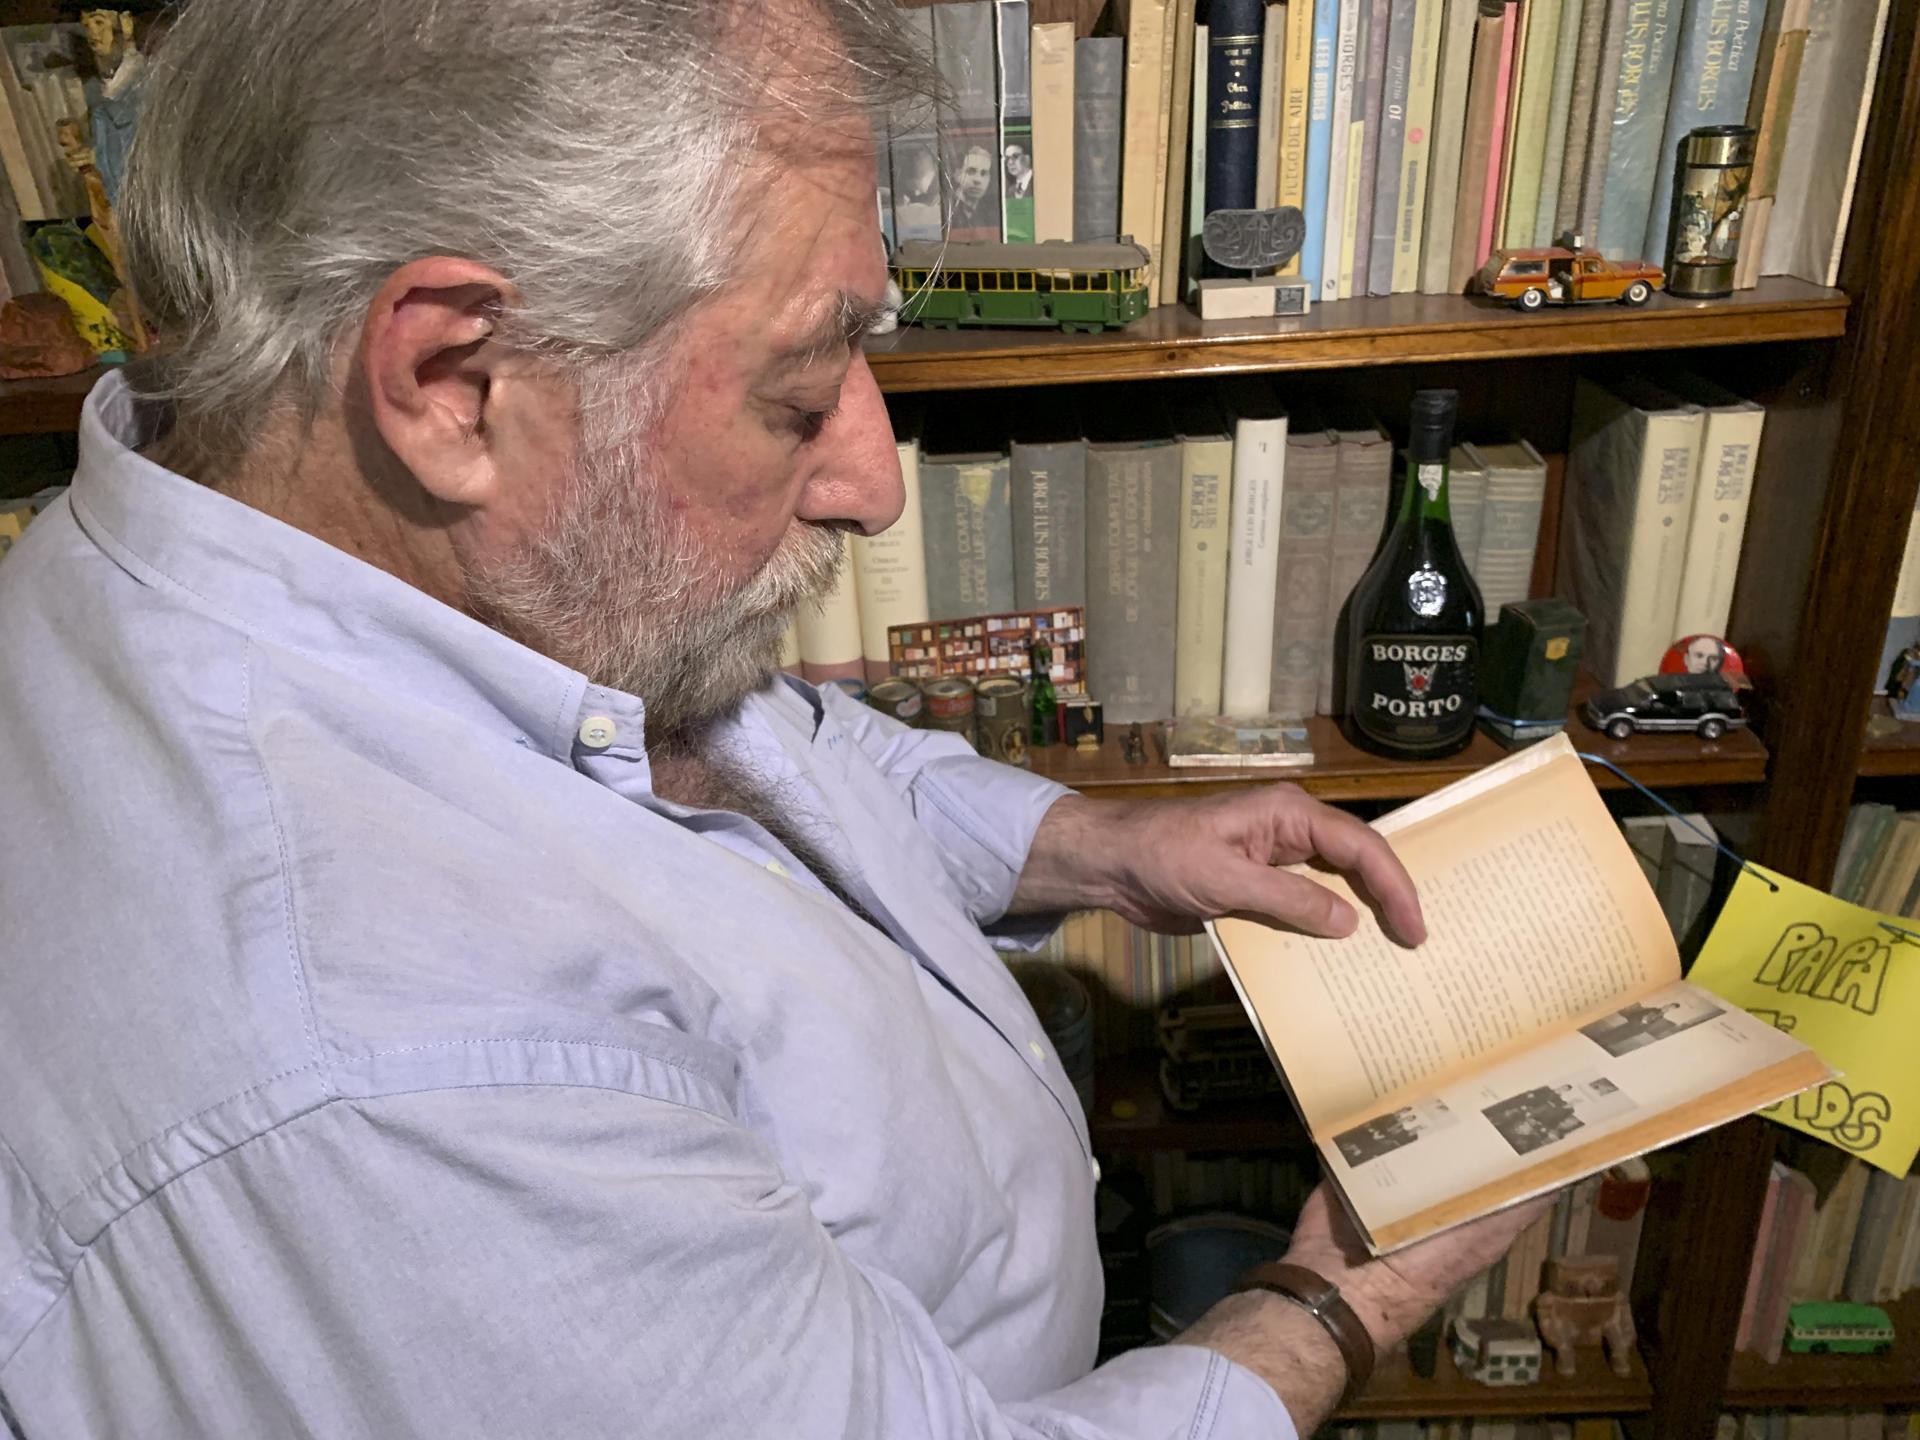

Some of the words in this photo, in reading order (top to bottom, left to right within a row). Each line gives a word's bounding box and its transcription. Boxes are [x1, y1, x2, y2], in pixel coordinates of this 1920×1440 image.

[1340, 34, 1356, 92] BORGES
[1727, 20, 1750, 72] Poética
[1391, 55, 1405, 100] miradas
[1697, 40, 1727, 112] BORGES
[1288, 86, 1304, 119] AIRE
[1388, 104, 1402, 121] 10
[1287, 123, 1301, 148] DEL
[1284, 150, 1301, 196] FUEGO
[1030, 470, 1050, 514] JORGE
[1190, 474, 1207, 530] BORGES
[1032, 515, 1050, 545] LUIS
[1034, 547, 1051, 601] BORGES
[1371, 644, 1469, 662] BORGES
[1371, 692, 1463, 718] PORTO
[1753, 921, 1892, 1016] PAPA
